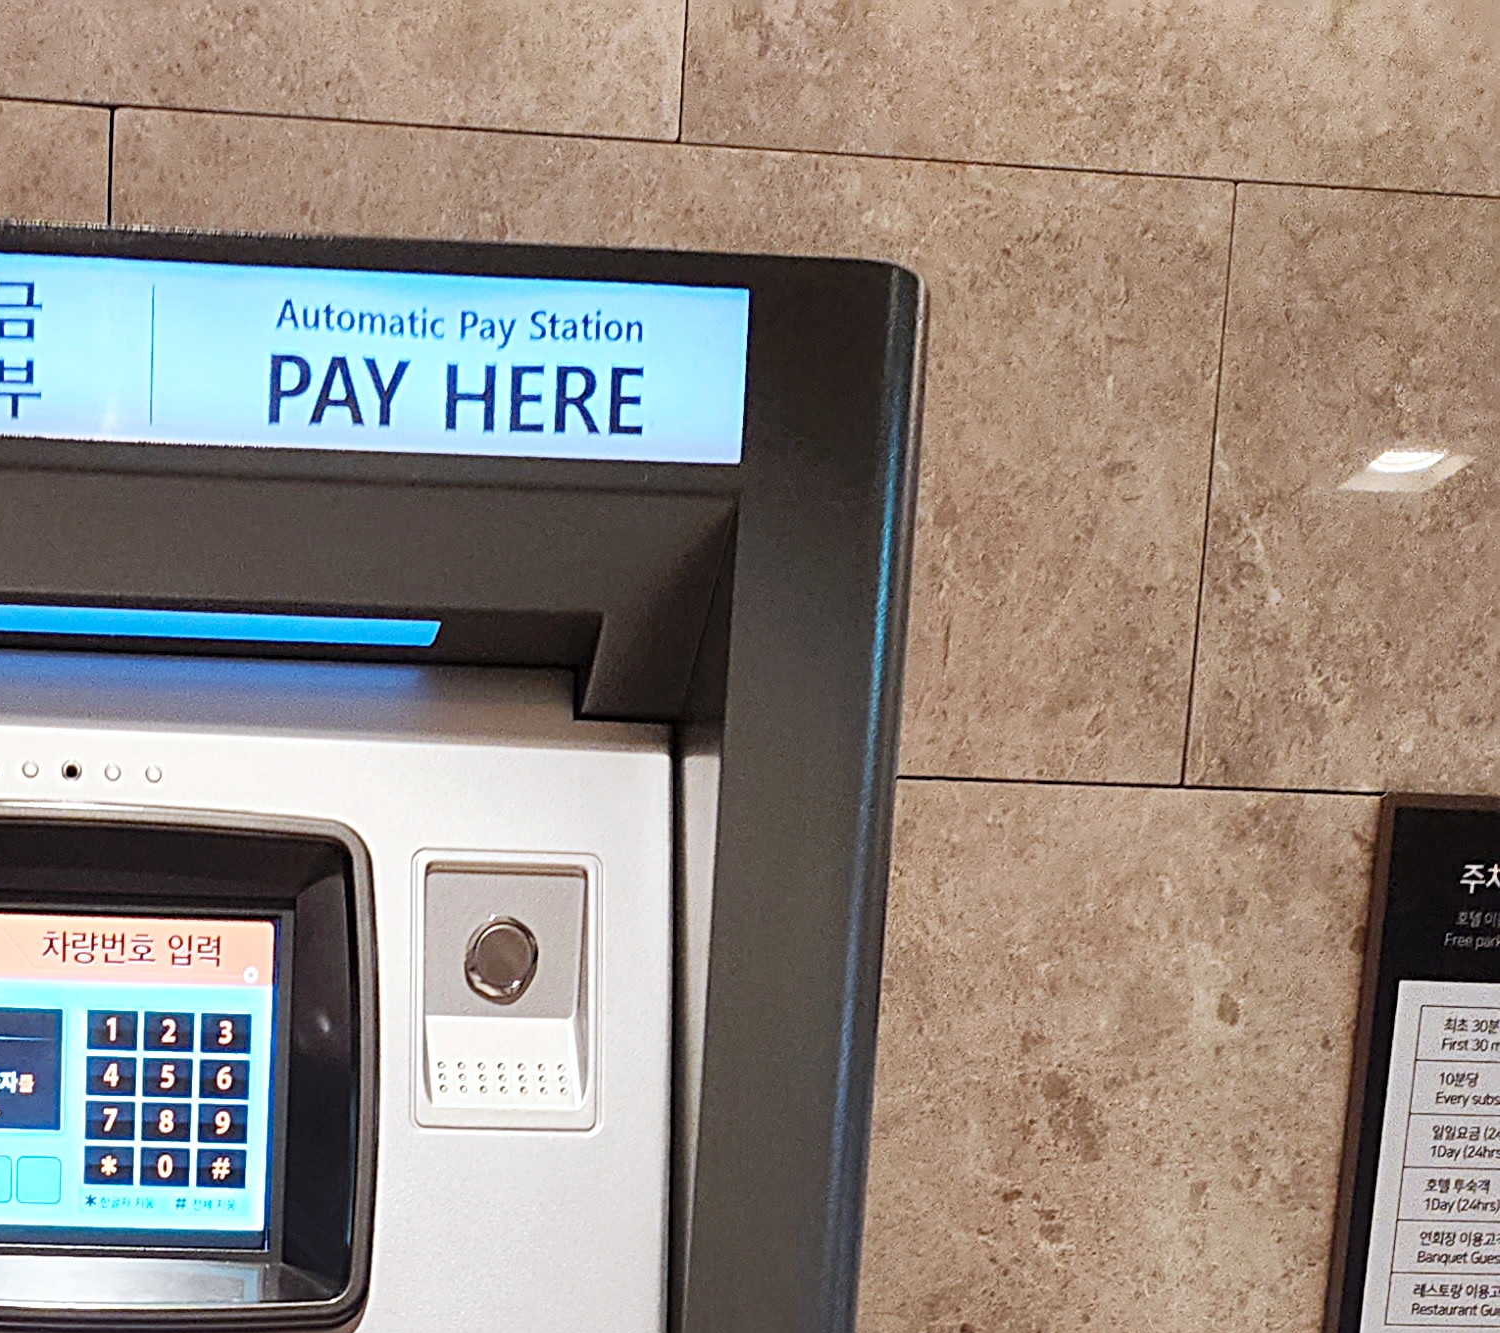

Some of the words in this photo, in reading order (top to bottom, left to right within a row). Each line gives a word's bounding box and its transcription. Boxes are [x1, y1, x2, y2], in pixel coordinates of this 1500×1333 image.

[276, 299, 445, 339] Automatic
[460, 311, 516, 350] Pay
[530, 310, 643, 343] Station
[268, 354, 411, 427] PAY
[445, 362, 644, 435] HERE
[1444, 932, 1472, 946] Free
[42, 930, 155, 965] 차량번호
[168, 934, 222, 967] 입력
[106, 1017, 117, 1042] 1
[161, 1018, 176, 1044] 2
[218, 1020, 233, 1045] 3
[1441, 1038, 1468, 1051] First
[1472, 1039, 1489, 1052] 30
[103, 1063, 119, 1087] 4
[160, 1064, 175, 1088] 5
[216, 1066, 233, 1090] 6
[1440, 1072, 1479, 1088] 10분당
[1435, 1092, 1470, 1108] Every
[103, 1108, 118, 1132] 7
[158, 1109, 174, 1133] 8
[215, 1110, 231, 1135] 9
[157, 1154, 173, 1179] 0
[1420, 1231, 1456, 1246] 연회장
[1460, 1231, 1500, 1247] 이용고
[1417, 1251, 1468, 1266] Banquet
[1413, 1283, 1463, 1299] 레스토랑
[1411, 1303, 1479, 1316] Restaurant
